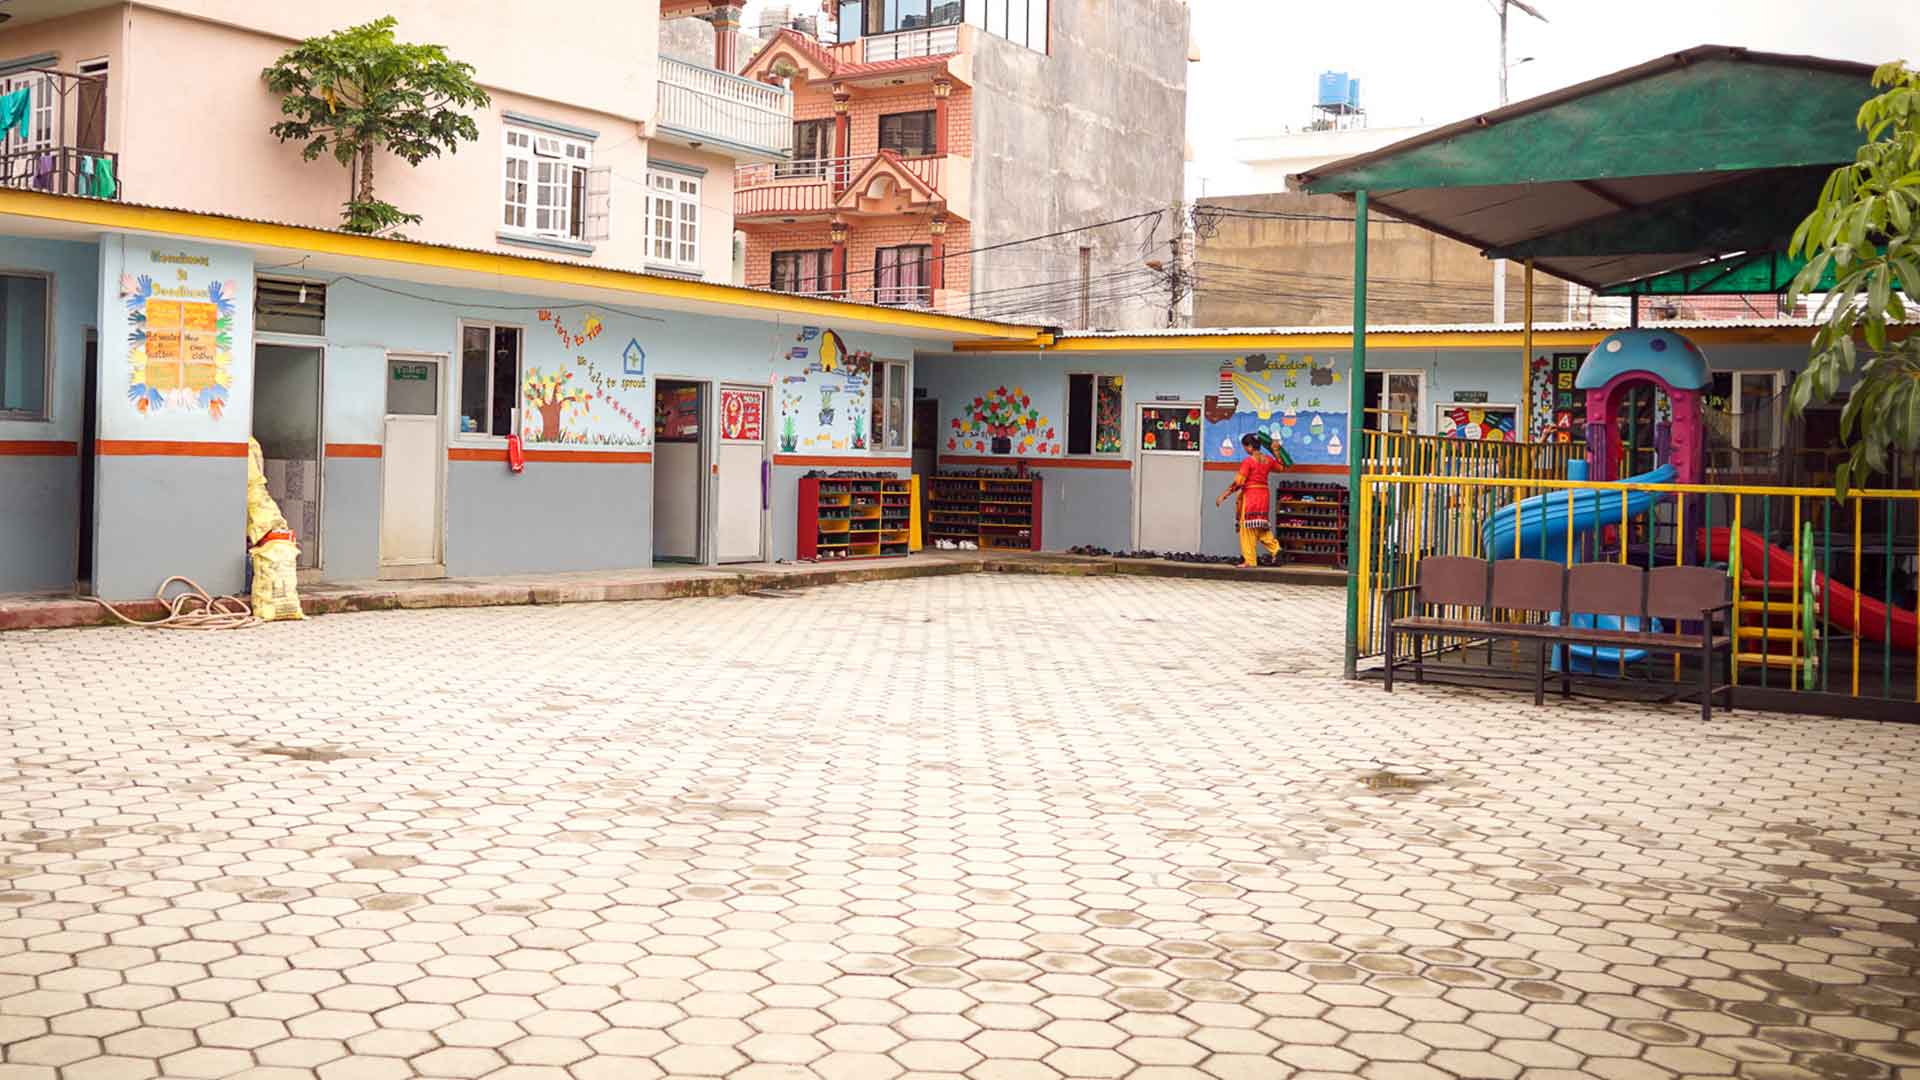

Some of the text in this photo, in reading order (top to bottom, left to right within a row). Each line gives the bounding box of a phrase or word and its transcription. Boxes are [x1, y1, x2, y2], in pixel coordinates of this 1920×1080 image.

[1266, 359, 1307, 370] Education
[1559, 357, 1576, 370] BE
[1156, 419, 1184, 430] COME
